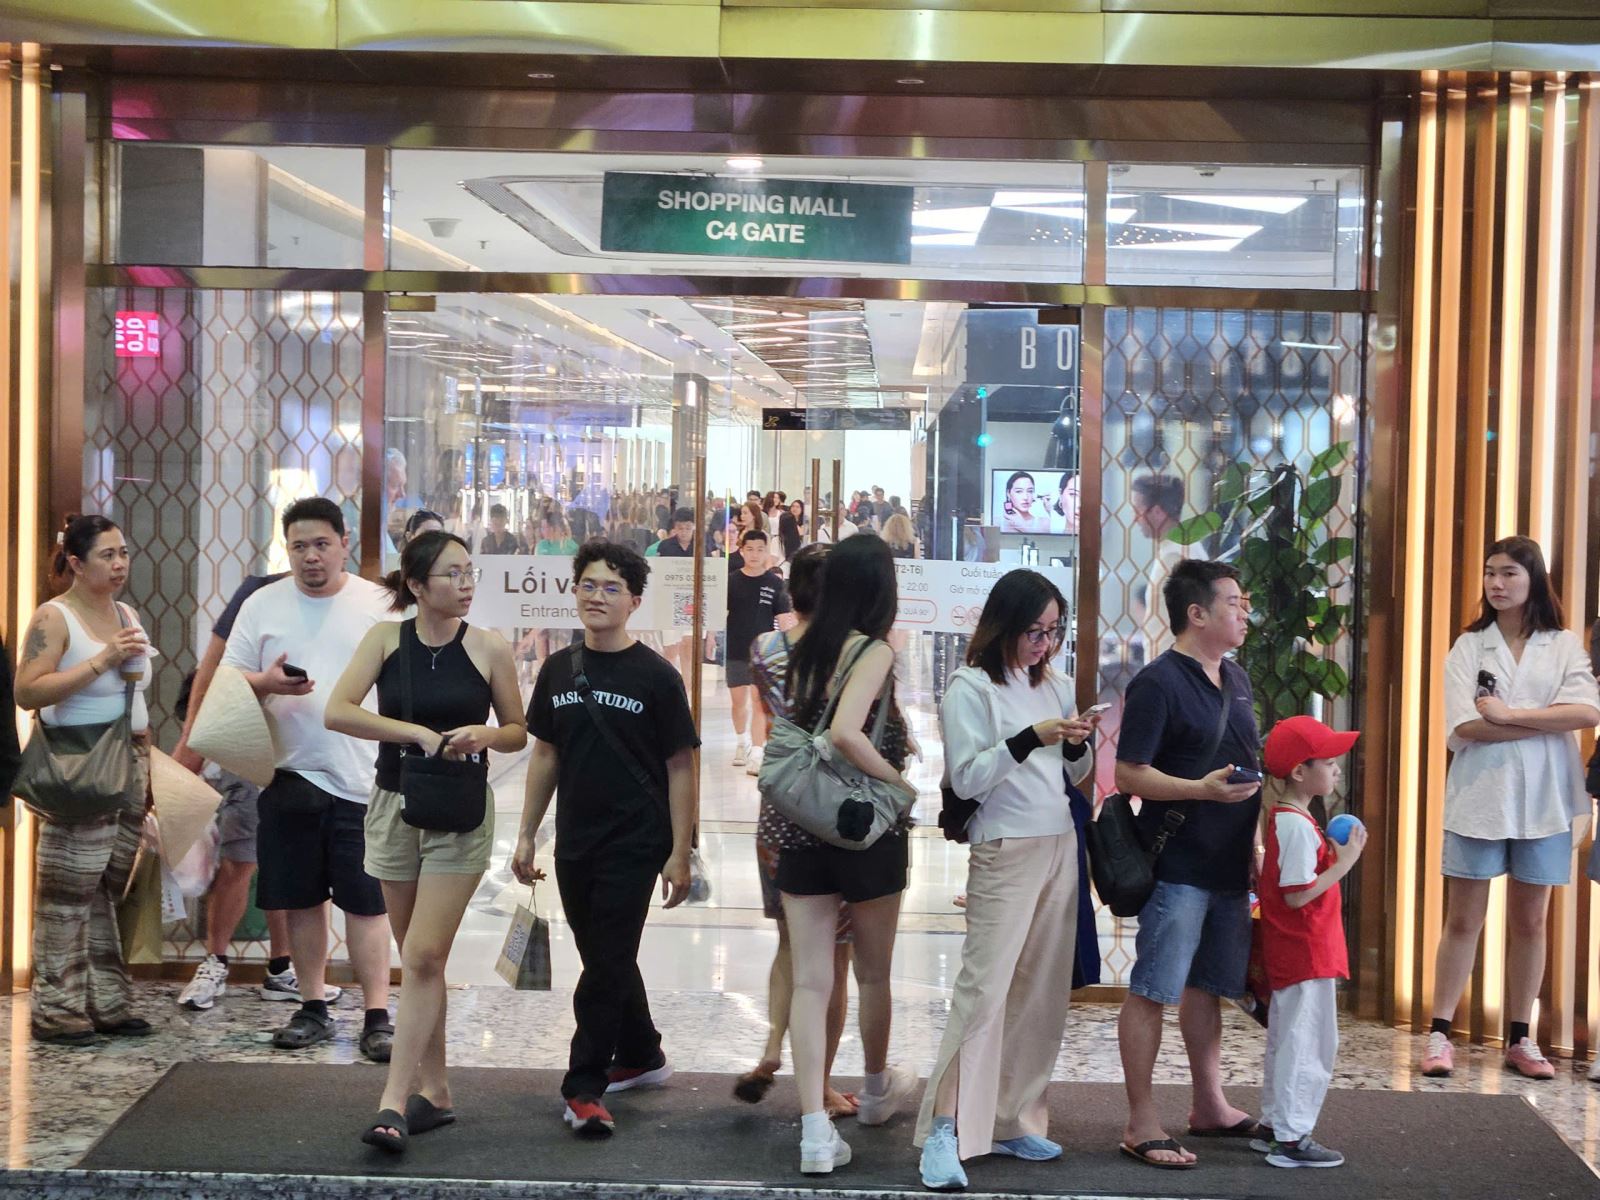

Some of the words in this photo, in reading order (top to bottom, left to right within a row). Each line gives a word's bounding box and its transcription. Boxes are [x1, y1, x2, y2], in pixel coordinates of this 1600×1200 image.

[658, 190, 782, 214] SHOPPING
[790, 195, 856, 217] MALL
[706, 220, 737, 240] C4
[742, 222, 805, 243] GATE
[504, 566, 546, 594] Lối
[894, 563, 923, 576] T2-T6)
[520, 603, 577, 618] Entranc
